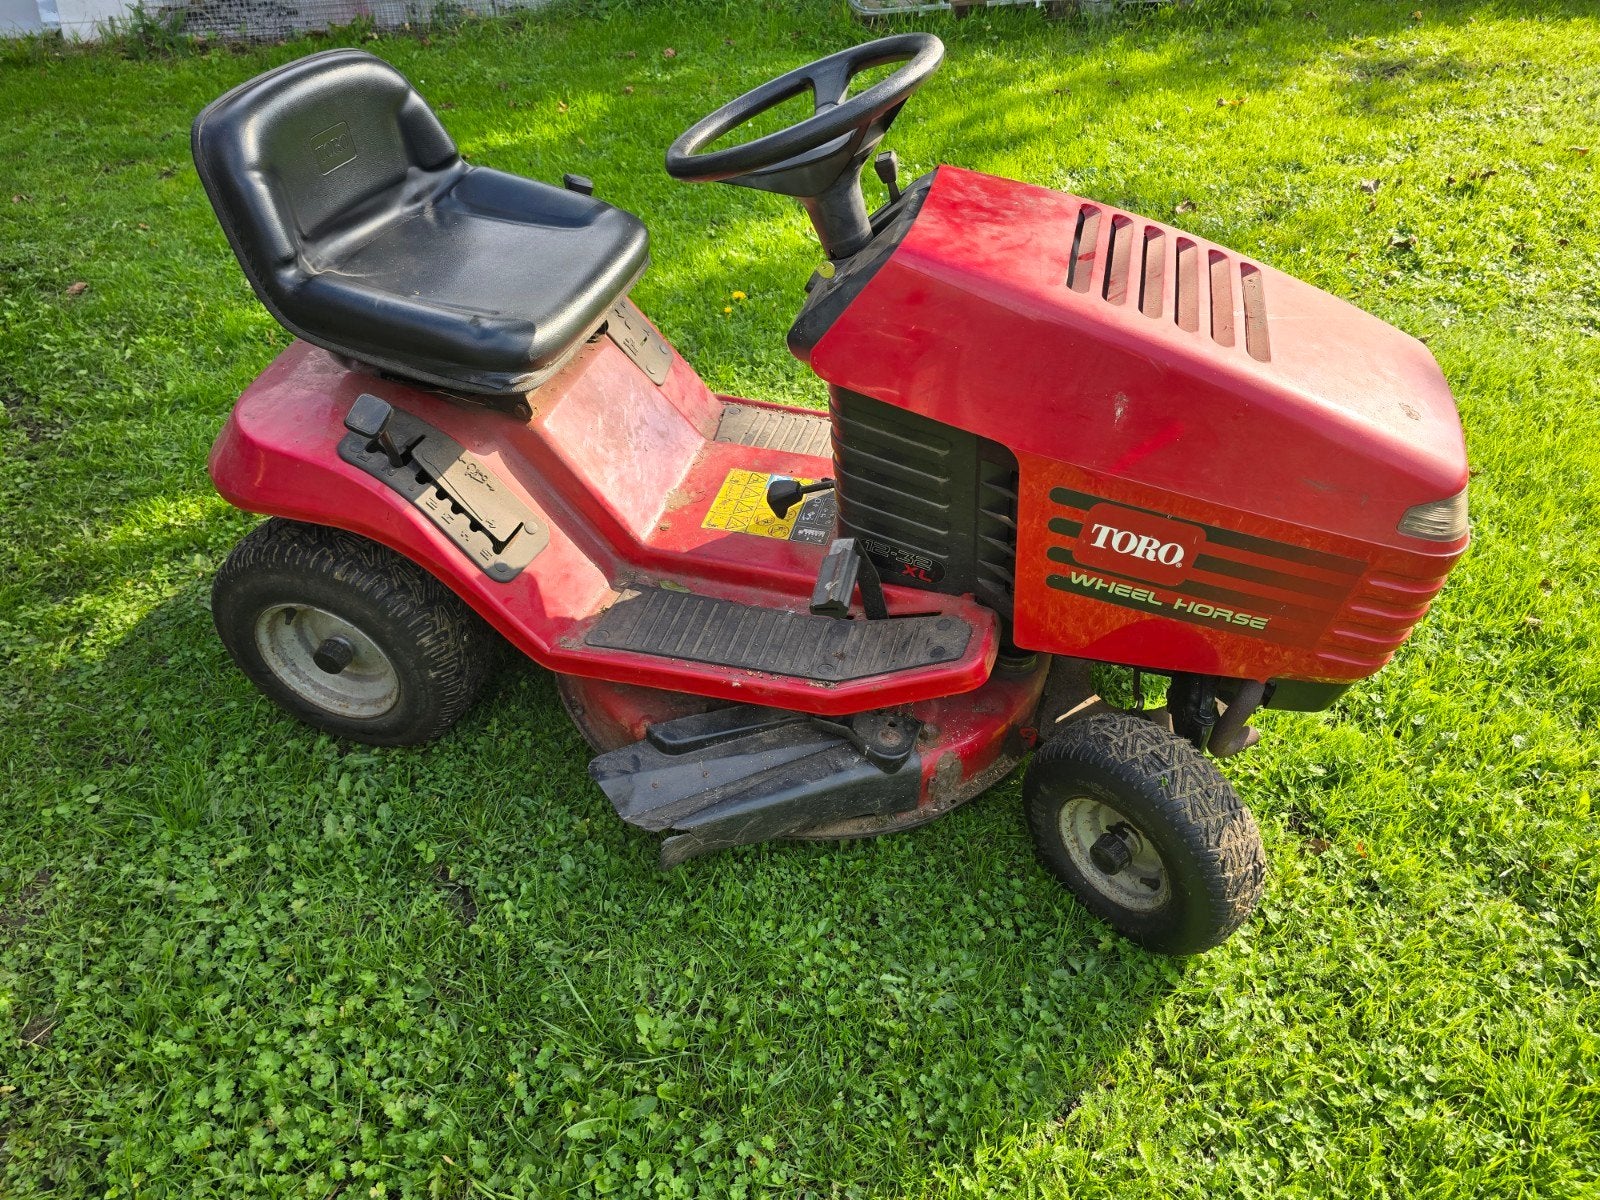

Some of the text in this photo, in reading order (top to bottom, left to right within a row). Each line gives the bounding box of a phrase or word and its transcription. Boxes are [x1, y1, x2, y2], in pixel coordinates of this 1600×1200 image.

[865, 540, 933, 571] 12-32
[1090, 523, 1185, 566] TORO
[901, 563, 933, 582] XL
[1070, 571, 1272, 630] WHEEL HORSE
